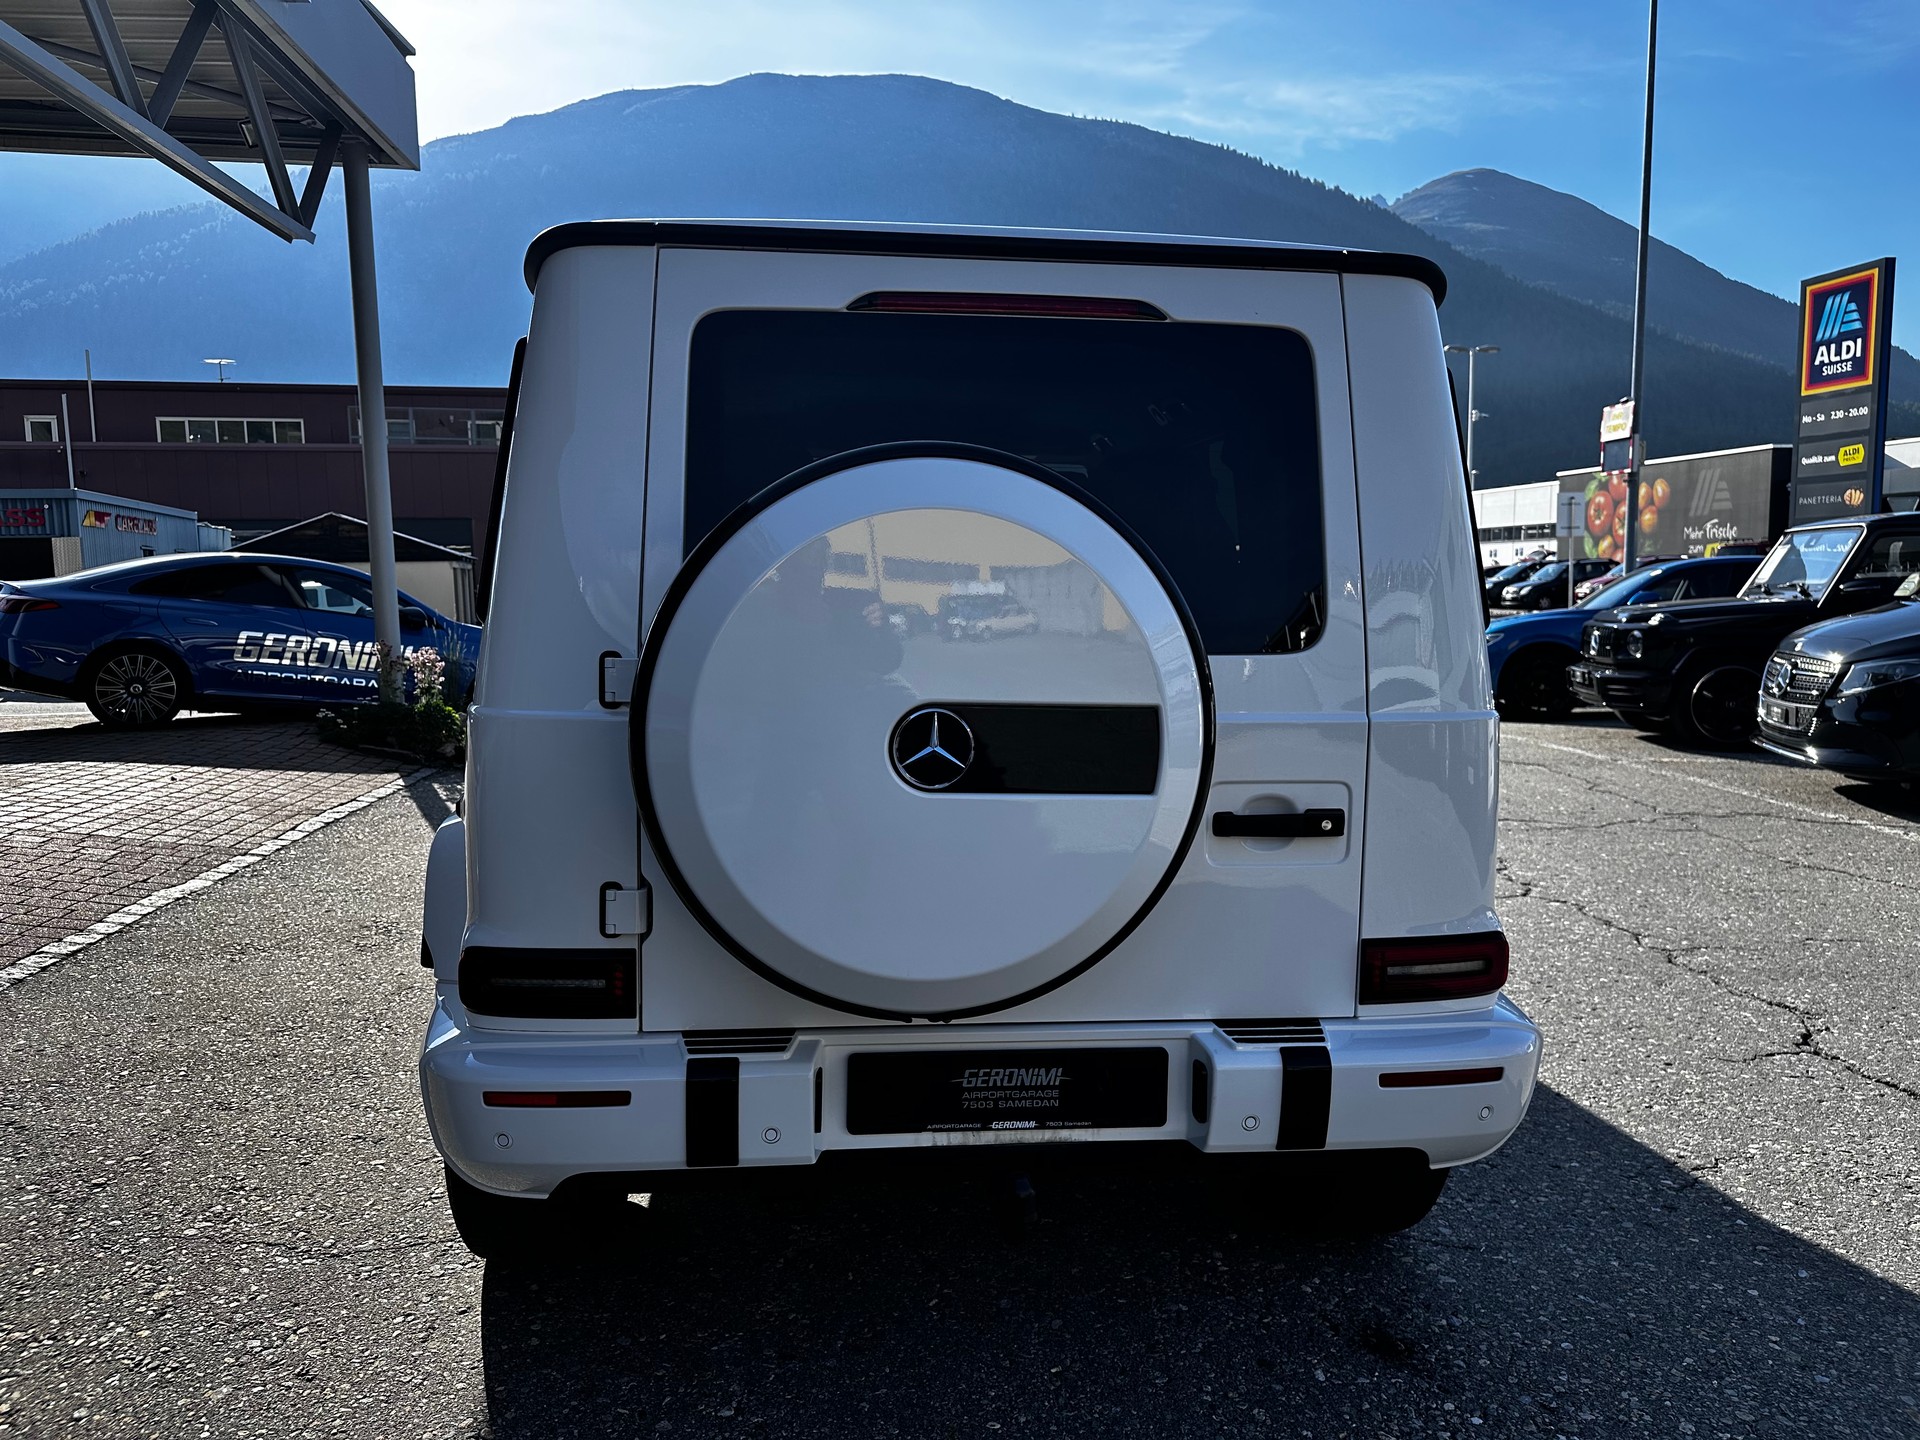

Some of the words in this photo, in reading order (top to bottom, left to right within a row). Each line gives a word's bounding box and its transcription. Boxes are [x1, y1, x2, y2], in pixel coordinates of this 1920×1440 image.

[1814, 337, 1862, 366] ALDI
[1822, 361, 1853, 376] SUISSE
[1802, 415, 1812, 424] Mo
[1816, 413, 1825, 422] Sa
[1849, 406, 1868, 417] 20.00
[1843, 447, 1860, 457] ALDI
[1799, 495, 1842, 505] PANETTERIA
[1684, 526, 1704, 540] Mehr
[1703, 518, 1738, 540] Frische
[1688, 544, 1704, 554] zum
[962, 1068, 1063, 1087] GERONIMI
[962, 1090, 1060, 1099] AIRPORTGARAGE
[962, 1101, 994, 1109] 7503
[998, 1100, 1059, 1108] SAMEDAN
[992, 1121, 1037, 1129] GERONIMI
